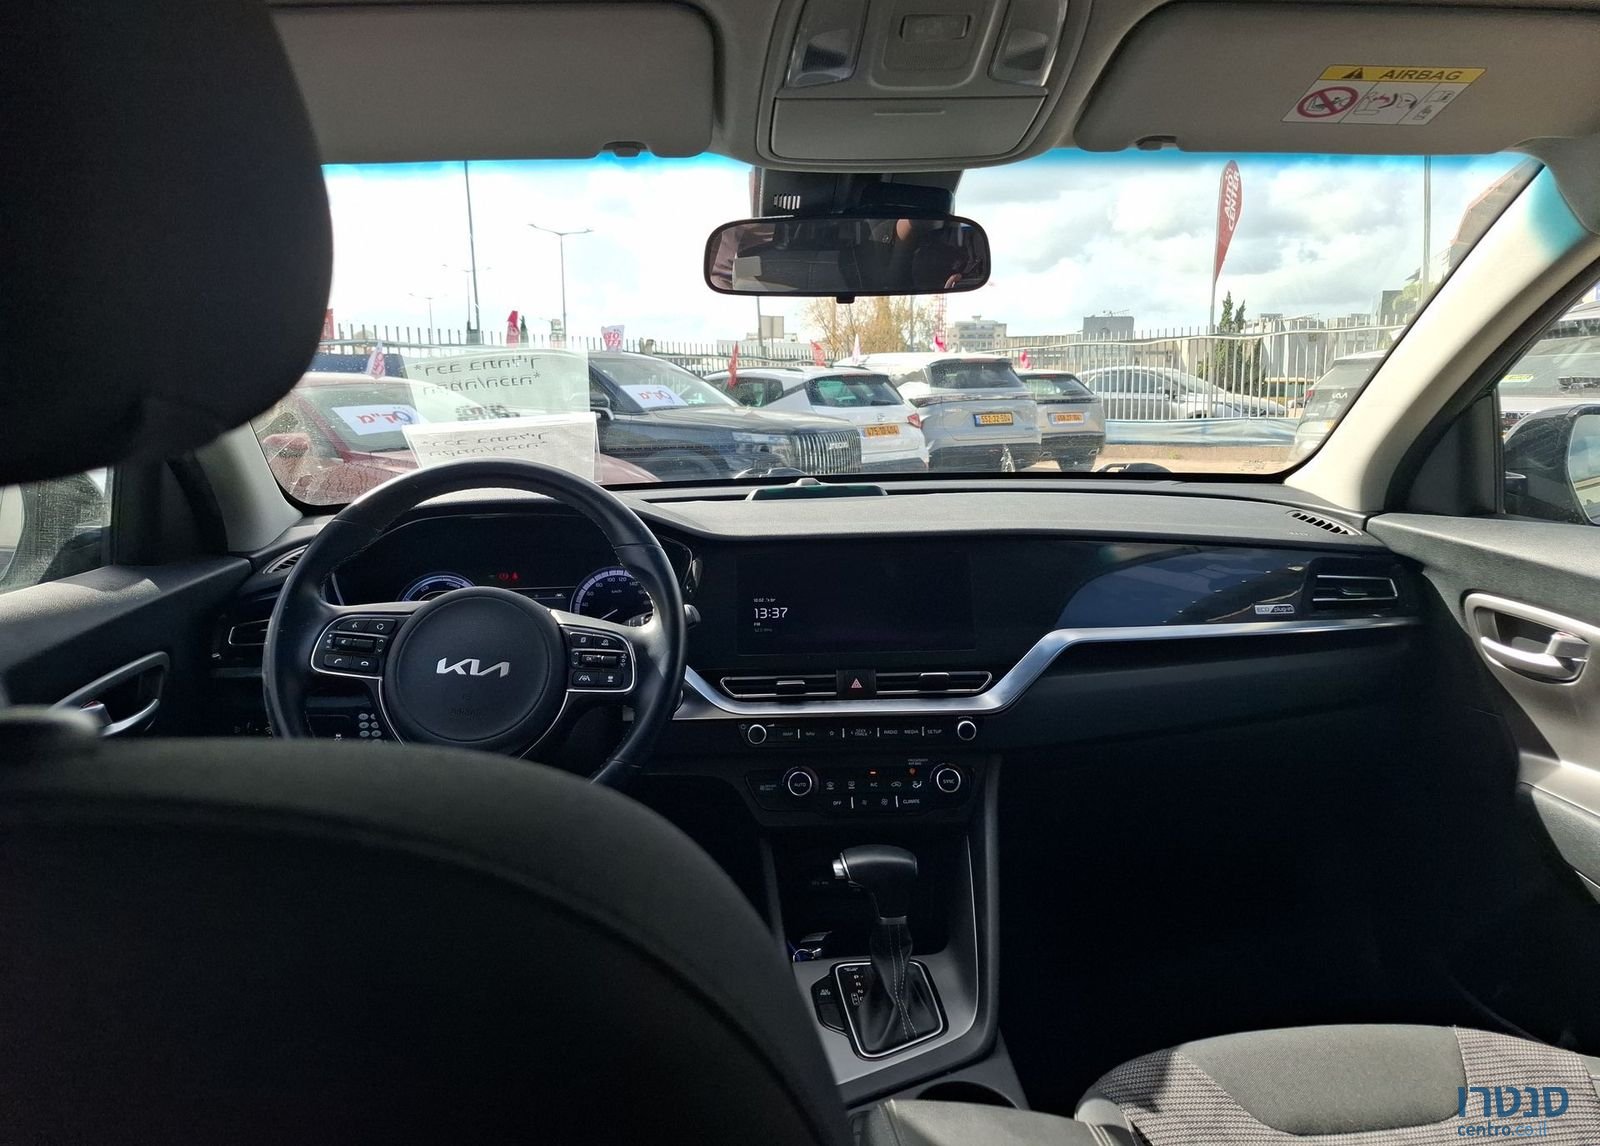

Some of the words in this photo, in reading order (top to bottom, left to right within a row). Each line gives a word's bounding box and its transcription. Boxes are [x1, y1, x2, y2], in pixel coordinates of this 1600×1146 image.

[1378, 68, 1464, 81] AIRBAG
[1224, 174, 1234, 219] AUTO
[1228, 170, 1240, 232] CENTER
[754, 607, 788, 619] 13:37
[436, 657, 510, 679] KIA
